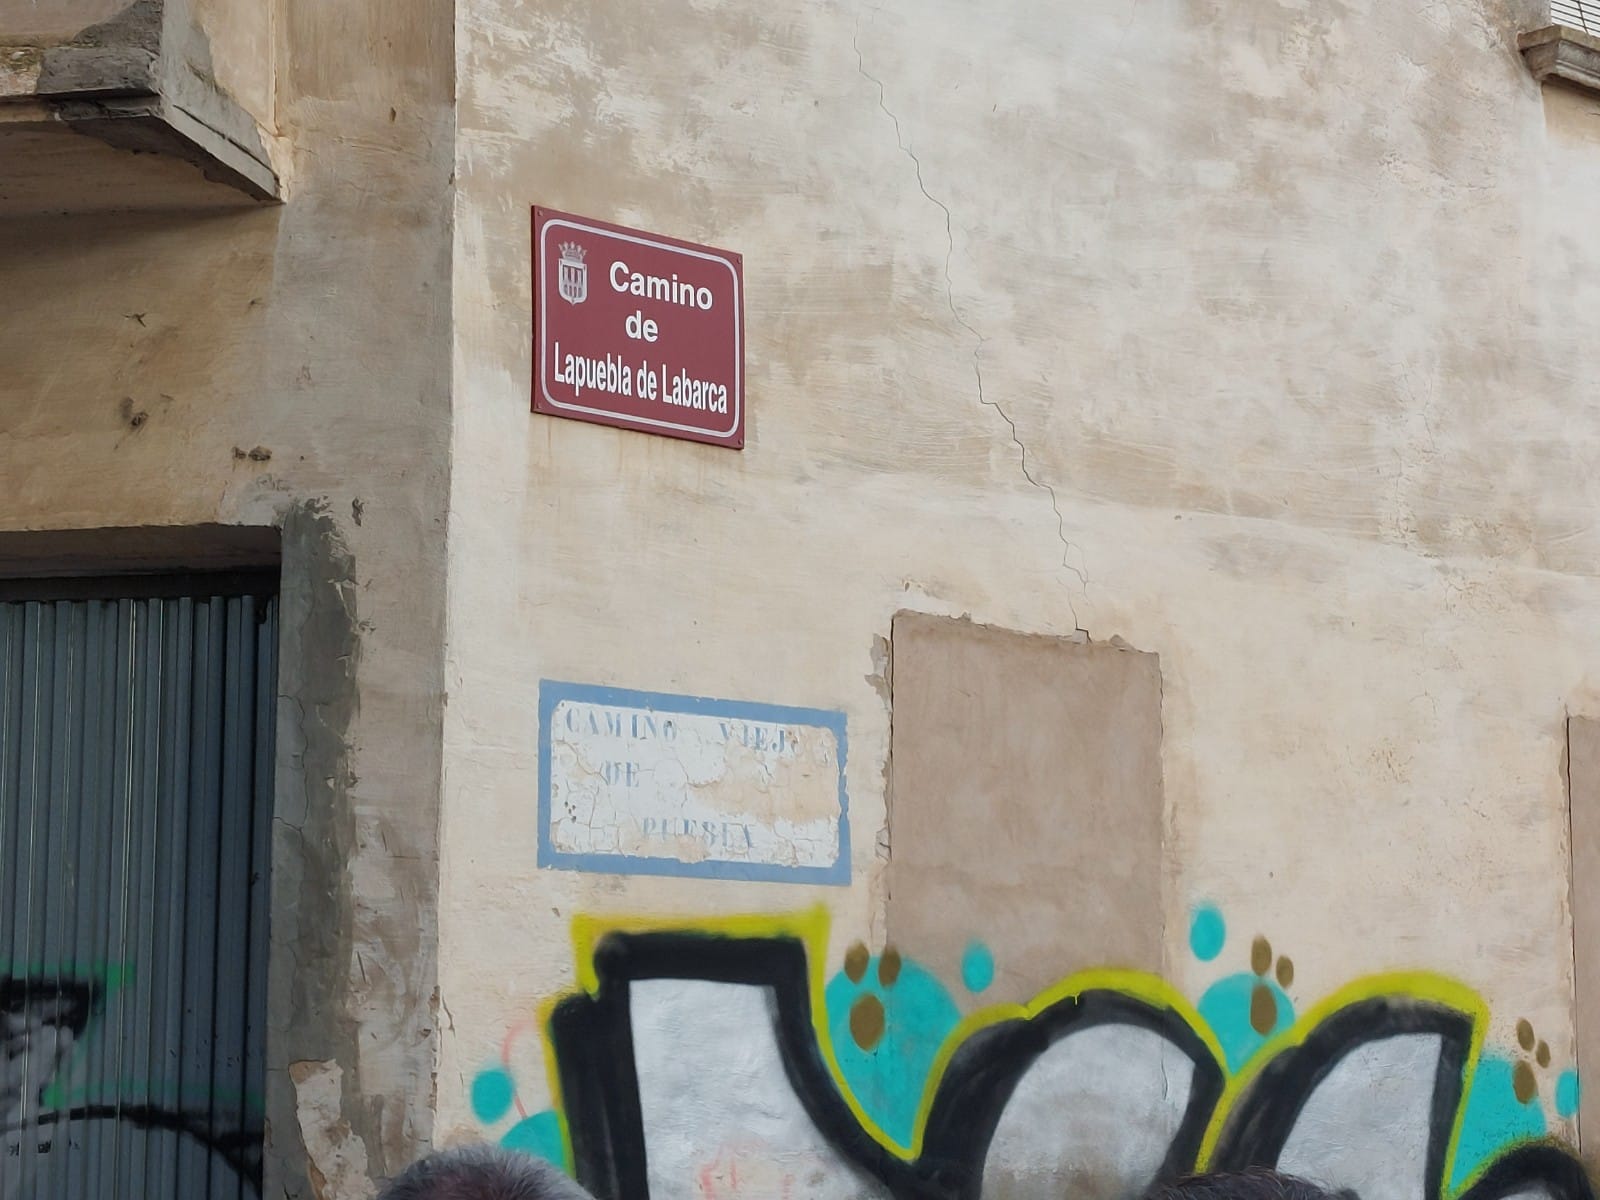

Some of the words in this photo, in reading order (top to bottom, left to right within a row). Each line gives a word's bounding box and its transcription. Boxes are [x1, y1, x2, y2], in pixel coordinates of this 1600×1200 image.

[609, 261, 713, 310] Camino
[625, 310, 659, 343] de
[554, 341, 632, 397] Lapuebla
[636, 360, 658, 401] de
[662, 364, 728, 414] Labarca
[566, 706, 677, 742] CAMINO
